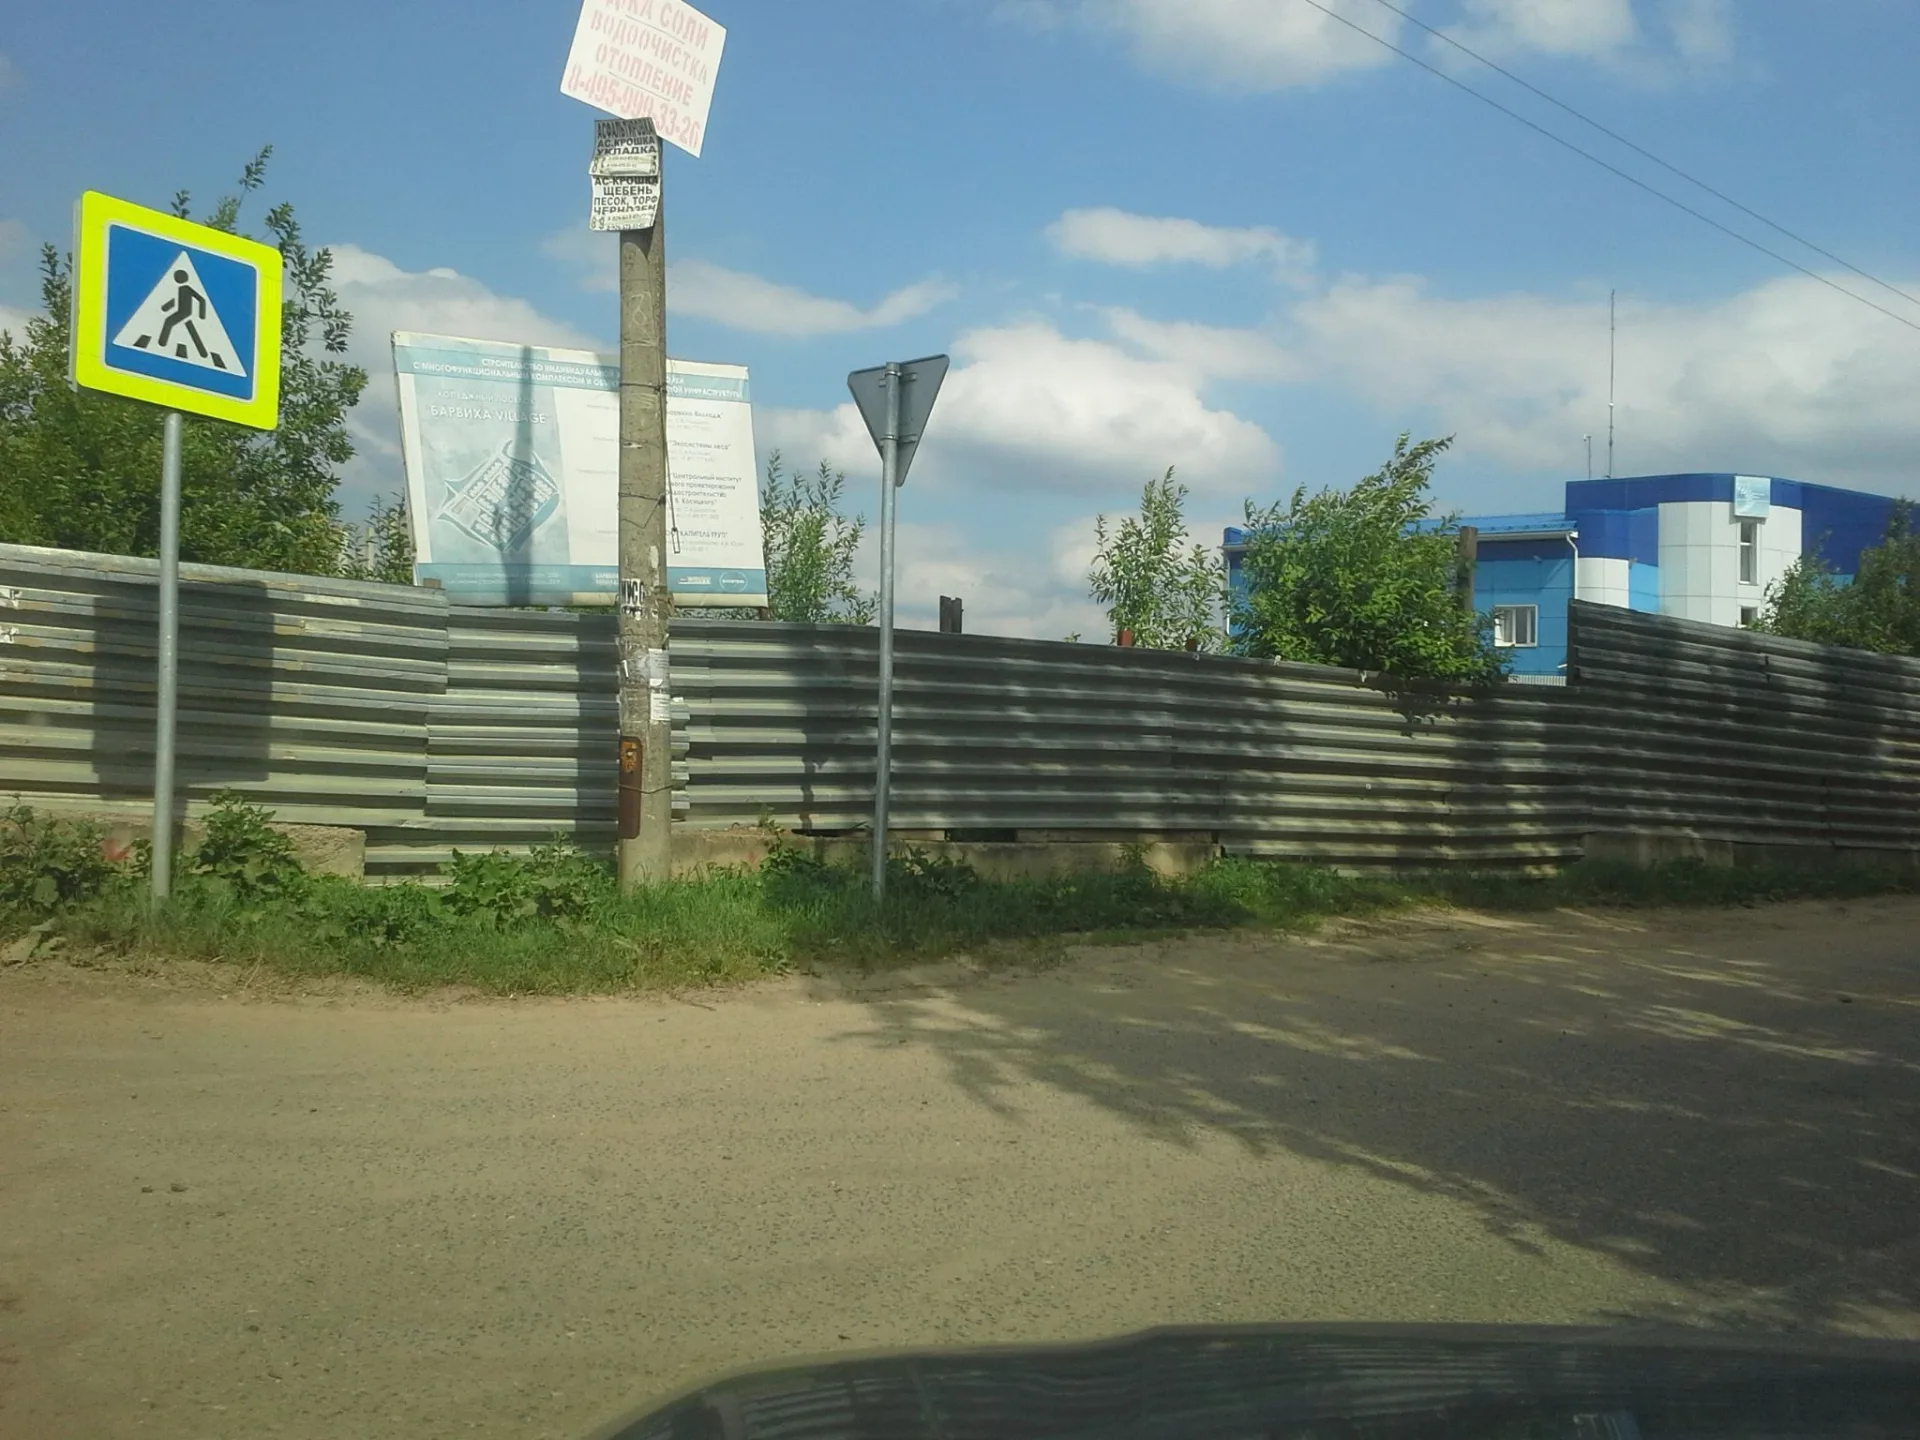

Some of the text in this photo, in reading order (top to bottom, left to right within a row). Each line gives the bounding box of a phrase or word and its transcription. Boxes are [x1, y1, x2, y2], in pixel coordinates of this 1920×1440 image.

[660, 2, 709, 50] СОЛИ
[590, 9, 708, 85] ВОДООЧИСТКА
[596, 43, 694, 107] ОТОПЛЕНИЕ
[597, 146, 657, 156] УКЛАДКА
[603, 186, 653, 197] ЩЕБЕНЬ
[633, 195, 658, 206] ТОРФ
